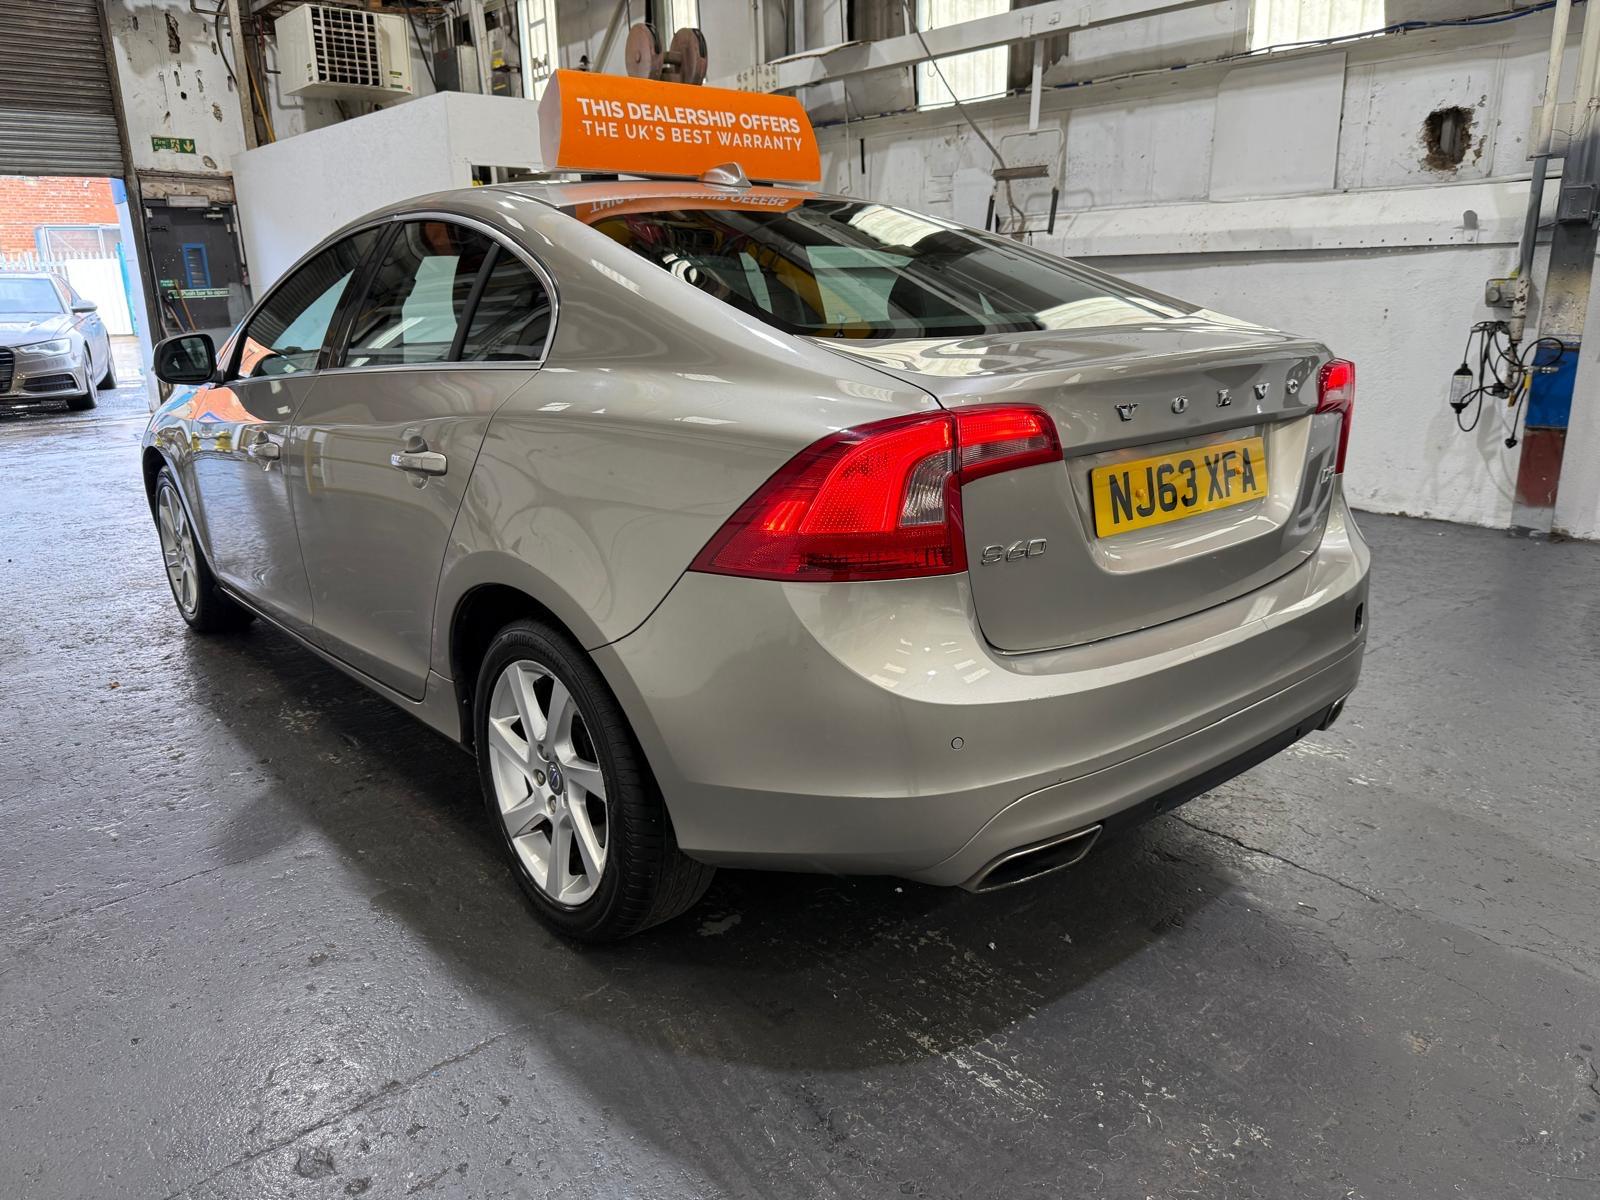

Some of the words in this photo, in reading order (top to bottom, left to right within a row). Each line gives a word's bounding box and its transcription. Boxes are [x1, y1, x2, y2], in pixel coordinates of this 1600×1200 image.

[577, 97, 624, 119] THIS
[628, 102, 736, 127] DEALERSHIP
[739, 113, 800, 134] OFFERS
[582, 119, 619, 138] THE
[624, 124, 666, 142] UK'S
[672, 128, 712, 145] BEST
[716, 131, 802, 152] WARRANTY
[1115, 379, 1299, 422] VOLVO
[1108, 458, 1197, 525] NJ63
[1204, 447, 1257, 502] XFA
[981, 538, 1048, 566] S60
